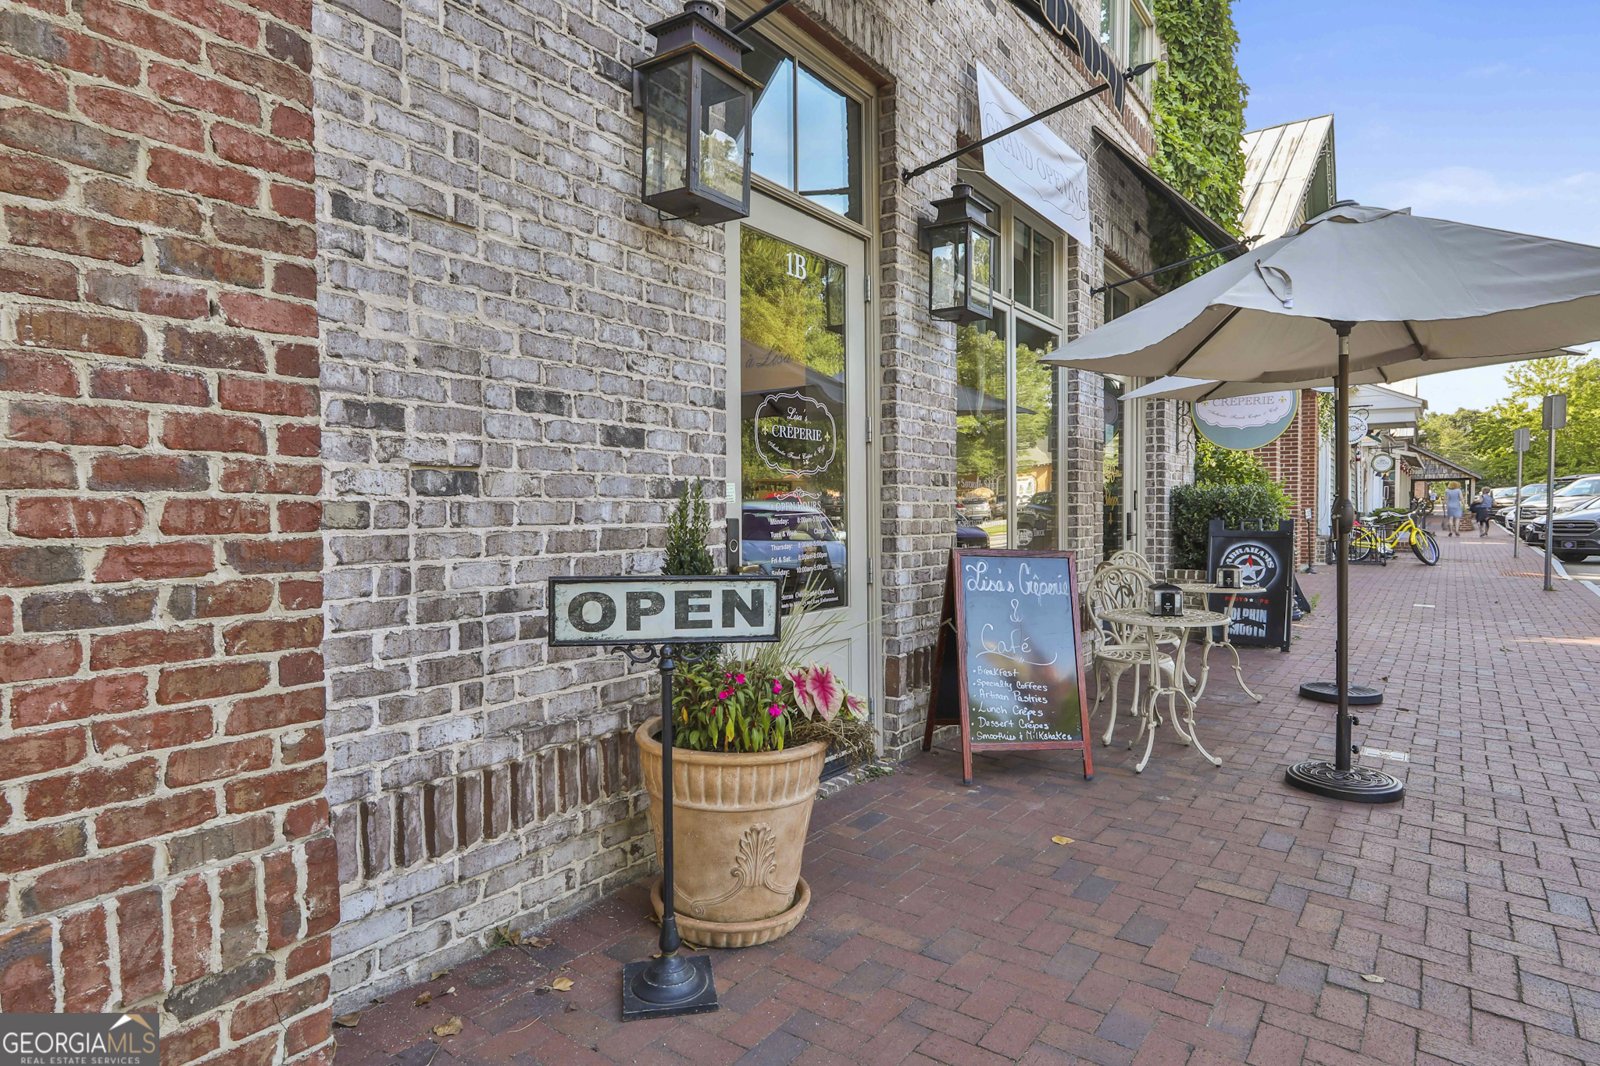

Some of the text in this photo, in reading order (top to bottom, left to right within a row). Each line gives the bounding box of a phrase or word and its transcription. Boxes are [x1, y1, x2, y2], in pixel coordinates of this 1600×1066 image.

[985, 113, 1087, 212] GRAND OPENING
[771, 423, 823, 442] CRÊPERIE
[966, 561, 1015, 592] Lisa's
[568, 588, 765, 633] OPEN
[1009, 599, 1022, 622] &
[981, 624, 1032, 653] Café
[976, 679, 1013, 692] Specialty
[979, 689, 1048, 704] Artisan Pastries
[978, 702, 1044, 720] Lunch Crêpes
[978, 716, 1014, 728] Dessert
